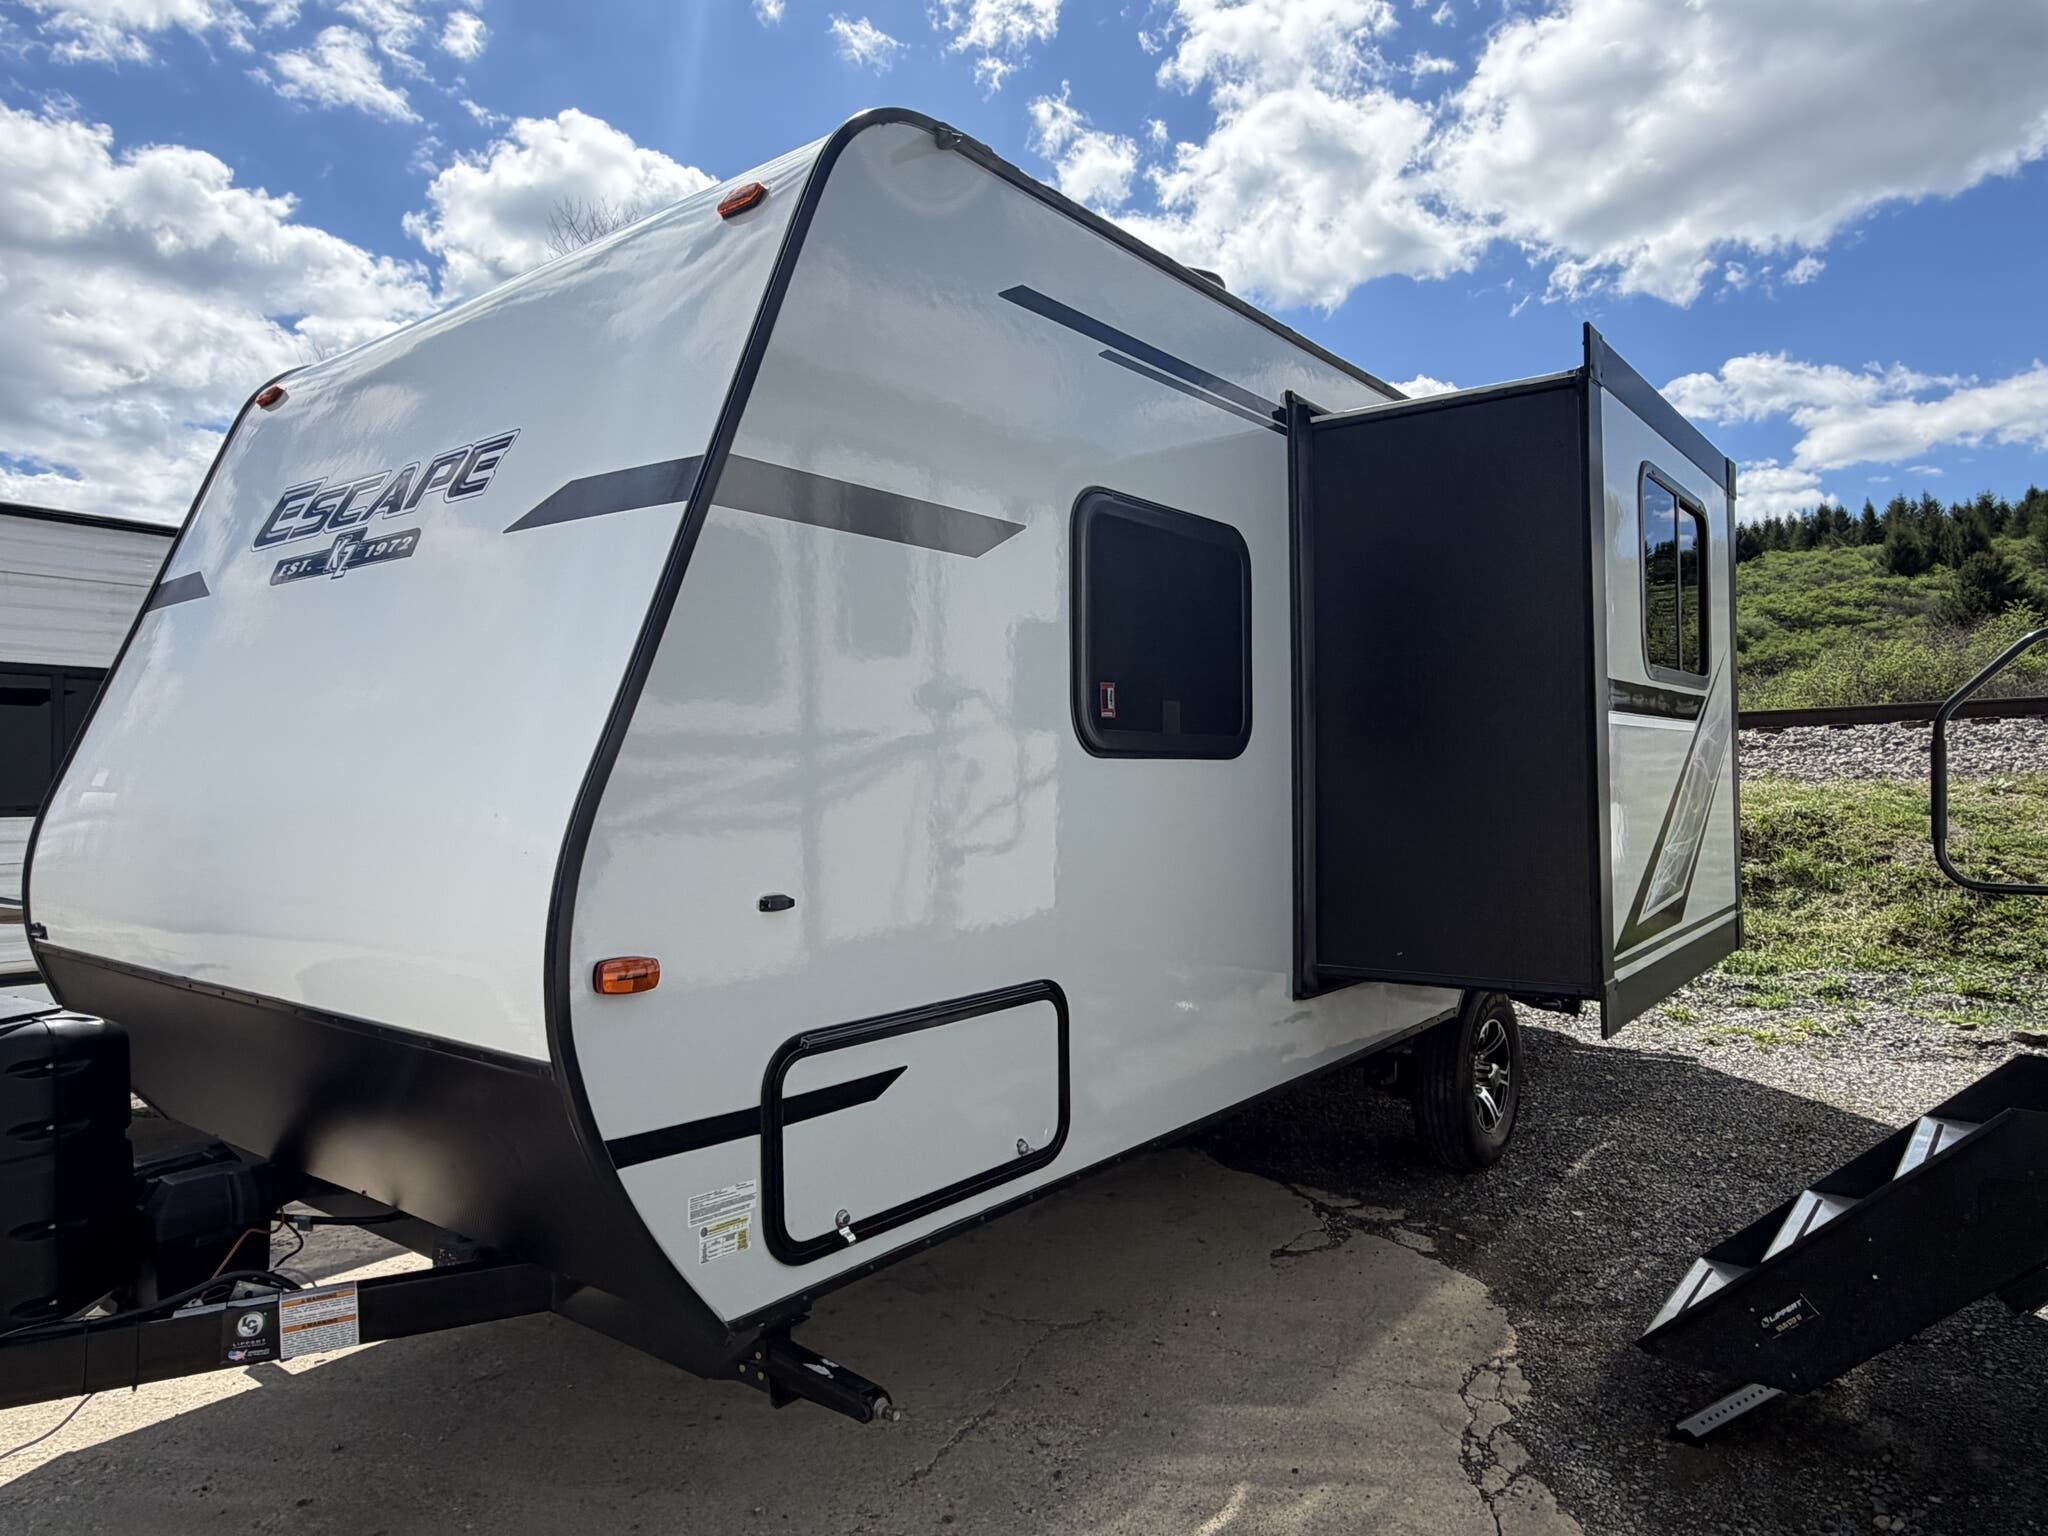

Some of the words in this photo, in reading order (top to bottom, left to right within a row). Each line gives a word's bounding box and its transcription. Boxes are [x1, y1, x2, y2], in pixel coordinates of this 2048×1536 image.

[252, 428, 521, 552] ESCAPE
[278, 558, 312, 577] EST.
[363, 535, 414, 559] 1972
[1769, 1299, 1802, 1323] LIPPERT
